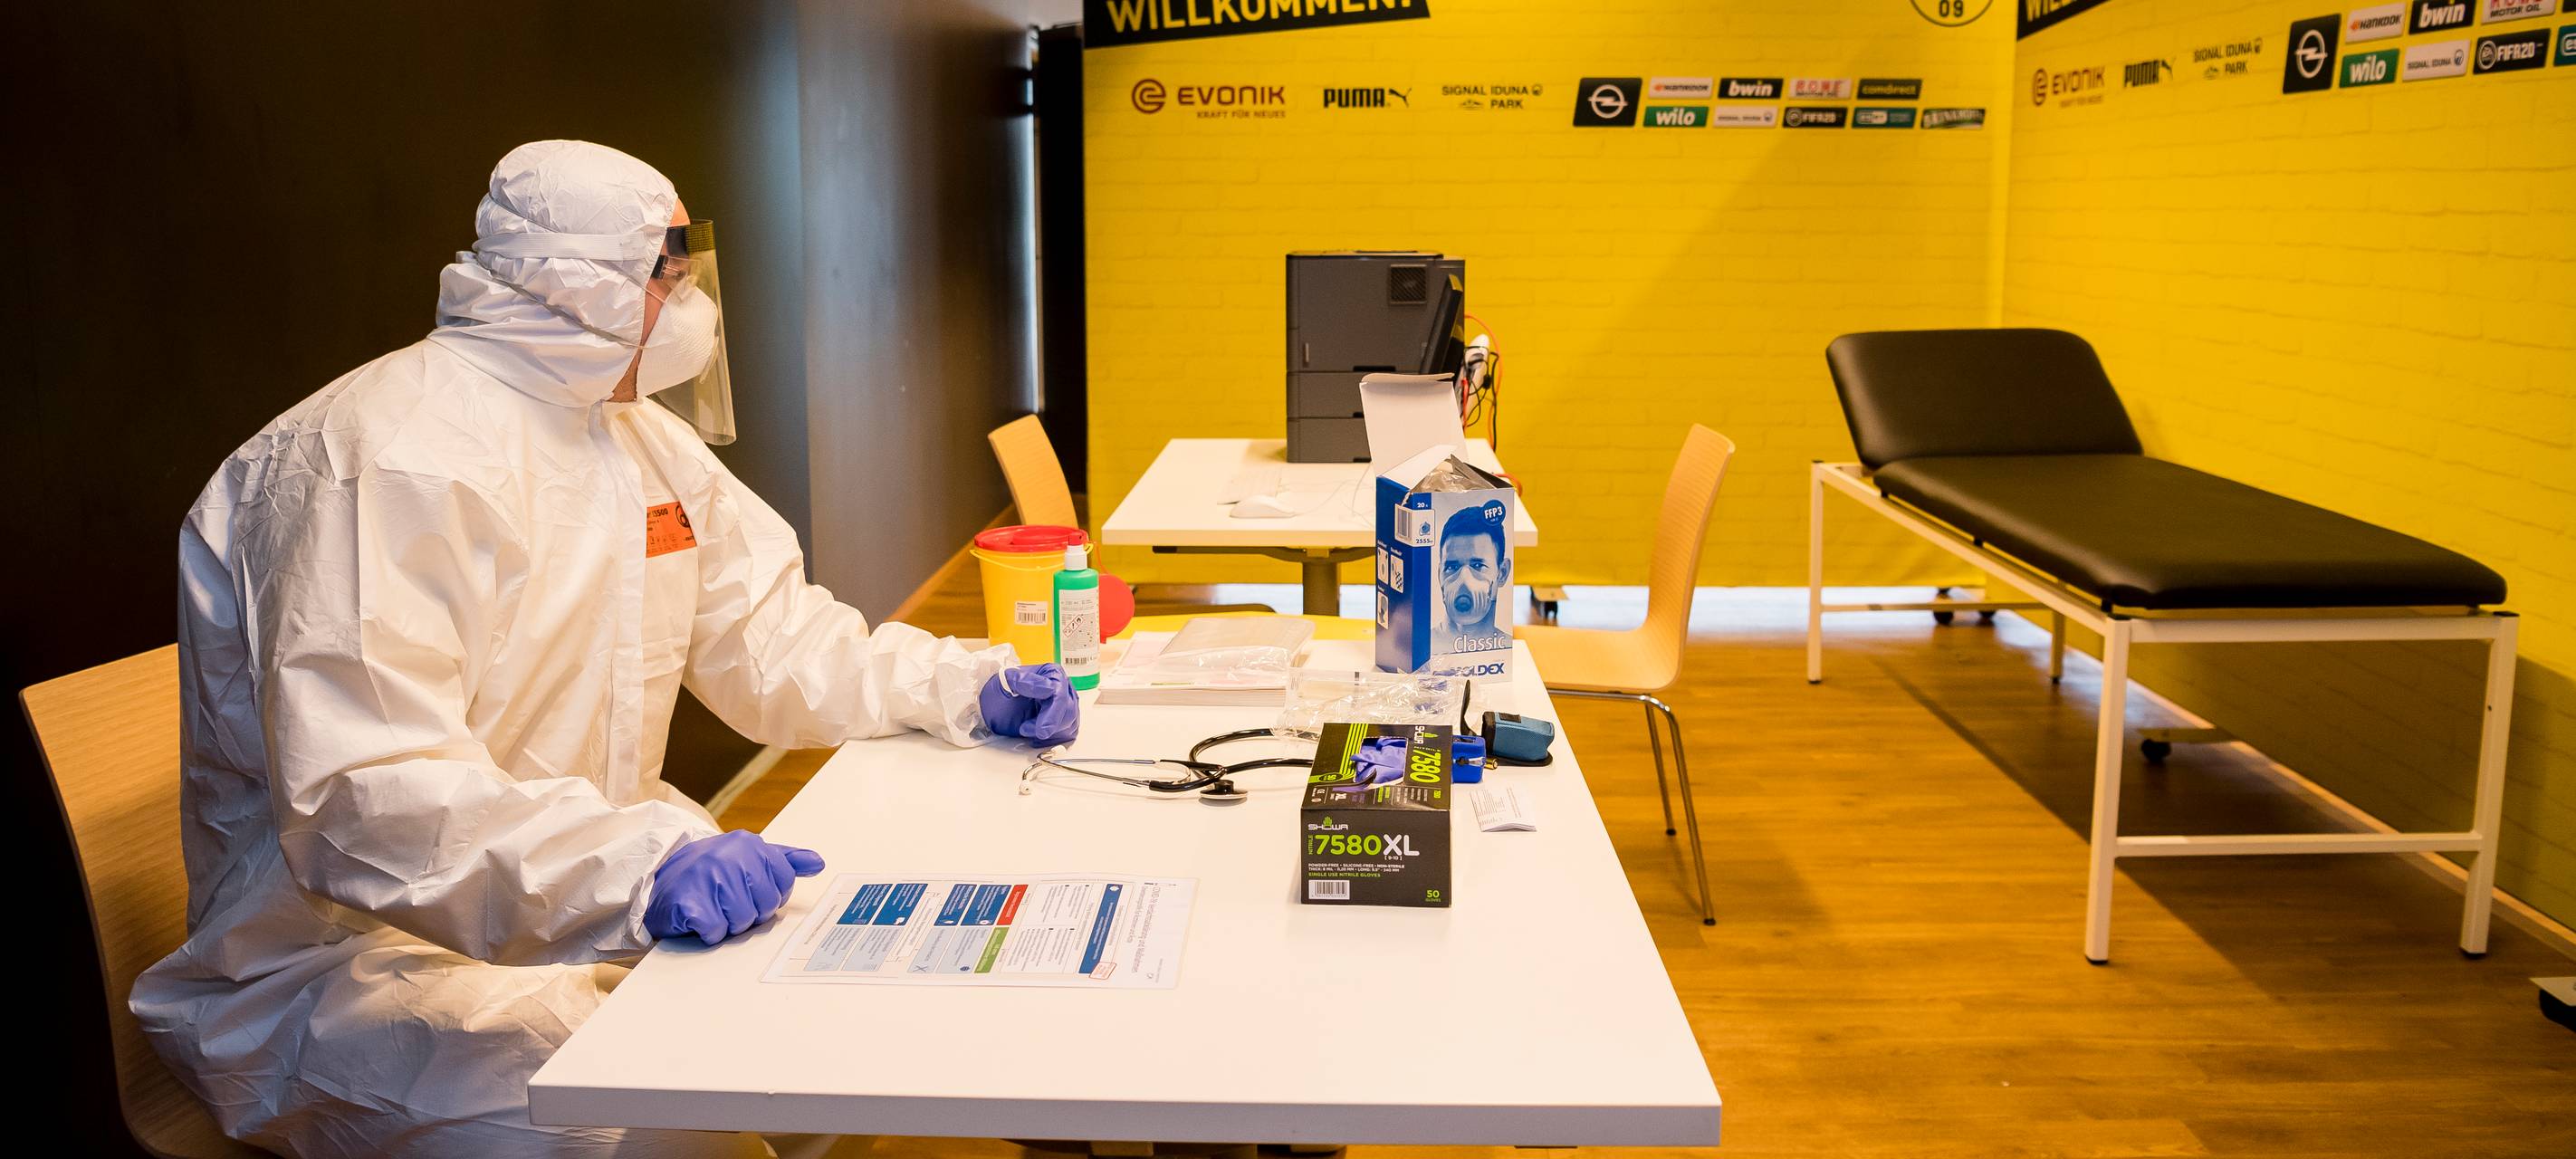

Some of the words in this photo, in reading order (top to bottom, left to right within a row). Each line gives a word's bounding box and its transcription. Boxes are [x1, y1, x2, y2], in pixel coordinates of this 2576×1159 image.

[1939, 0, 1963, 17] 09
[2418, 2, 2466, 28] bwin
[2491, 6, 2523, 17] MOTOR
[2525, 4, 2542, 13] OIL
[2193, 47, 2224, 63] SIGNAL
[2226, 42, 2253, 58] IDUNA
[2123, 60, 2160, 88] PUMA
[2225, 61, 2248, 74] PARK
[2350, 55, 2386, 82] wilo
[1728, 80, 1773, 97] bwin
[2051, 67, 2106, 95] EVONIK
[1178, 86, 1285, 105] EVONIK
[1324, 89, 1385, 108] PUMA
[1441, 85, 1487, 96] SIGNAL
[1490, 86, 1528, 96] IDUNA
[1490, 99, 1523, 109] PARK
[1656, 108, 1696, 126] wilo
[1484, 506, 1503, 520] FFP3
[1453, 632, 1506, 653] Classic
[1454, 663, 1505, 677] OLDEX
[1410, 748, 1441, 783] 7580
[1426, 890, 1440, 898] 50
